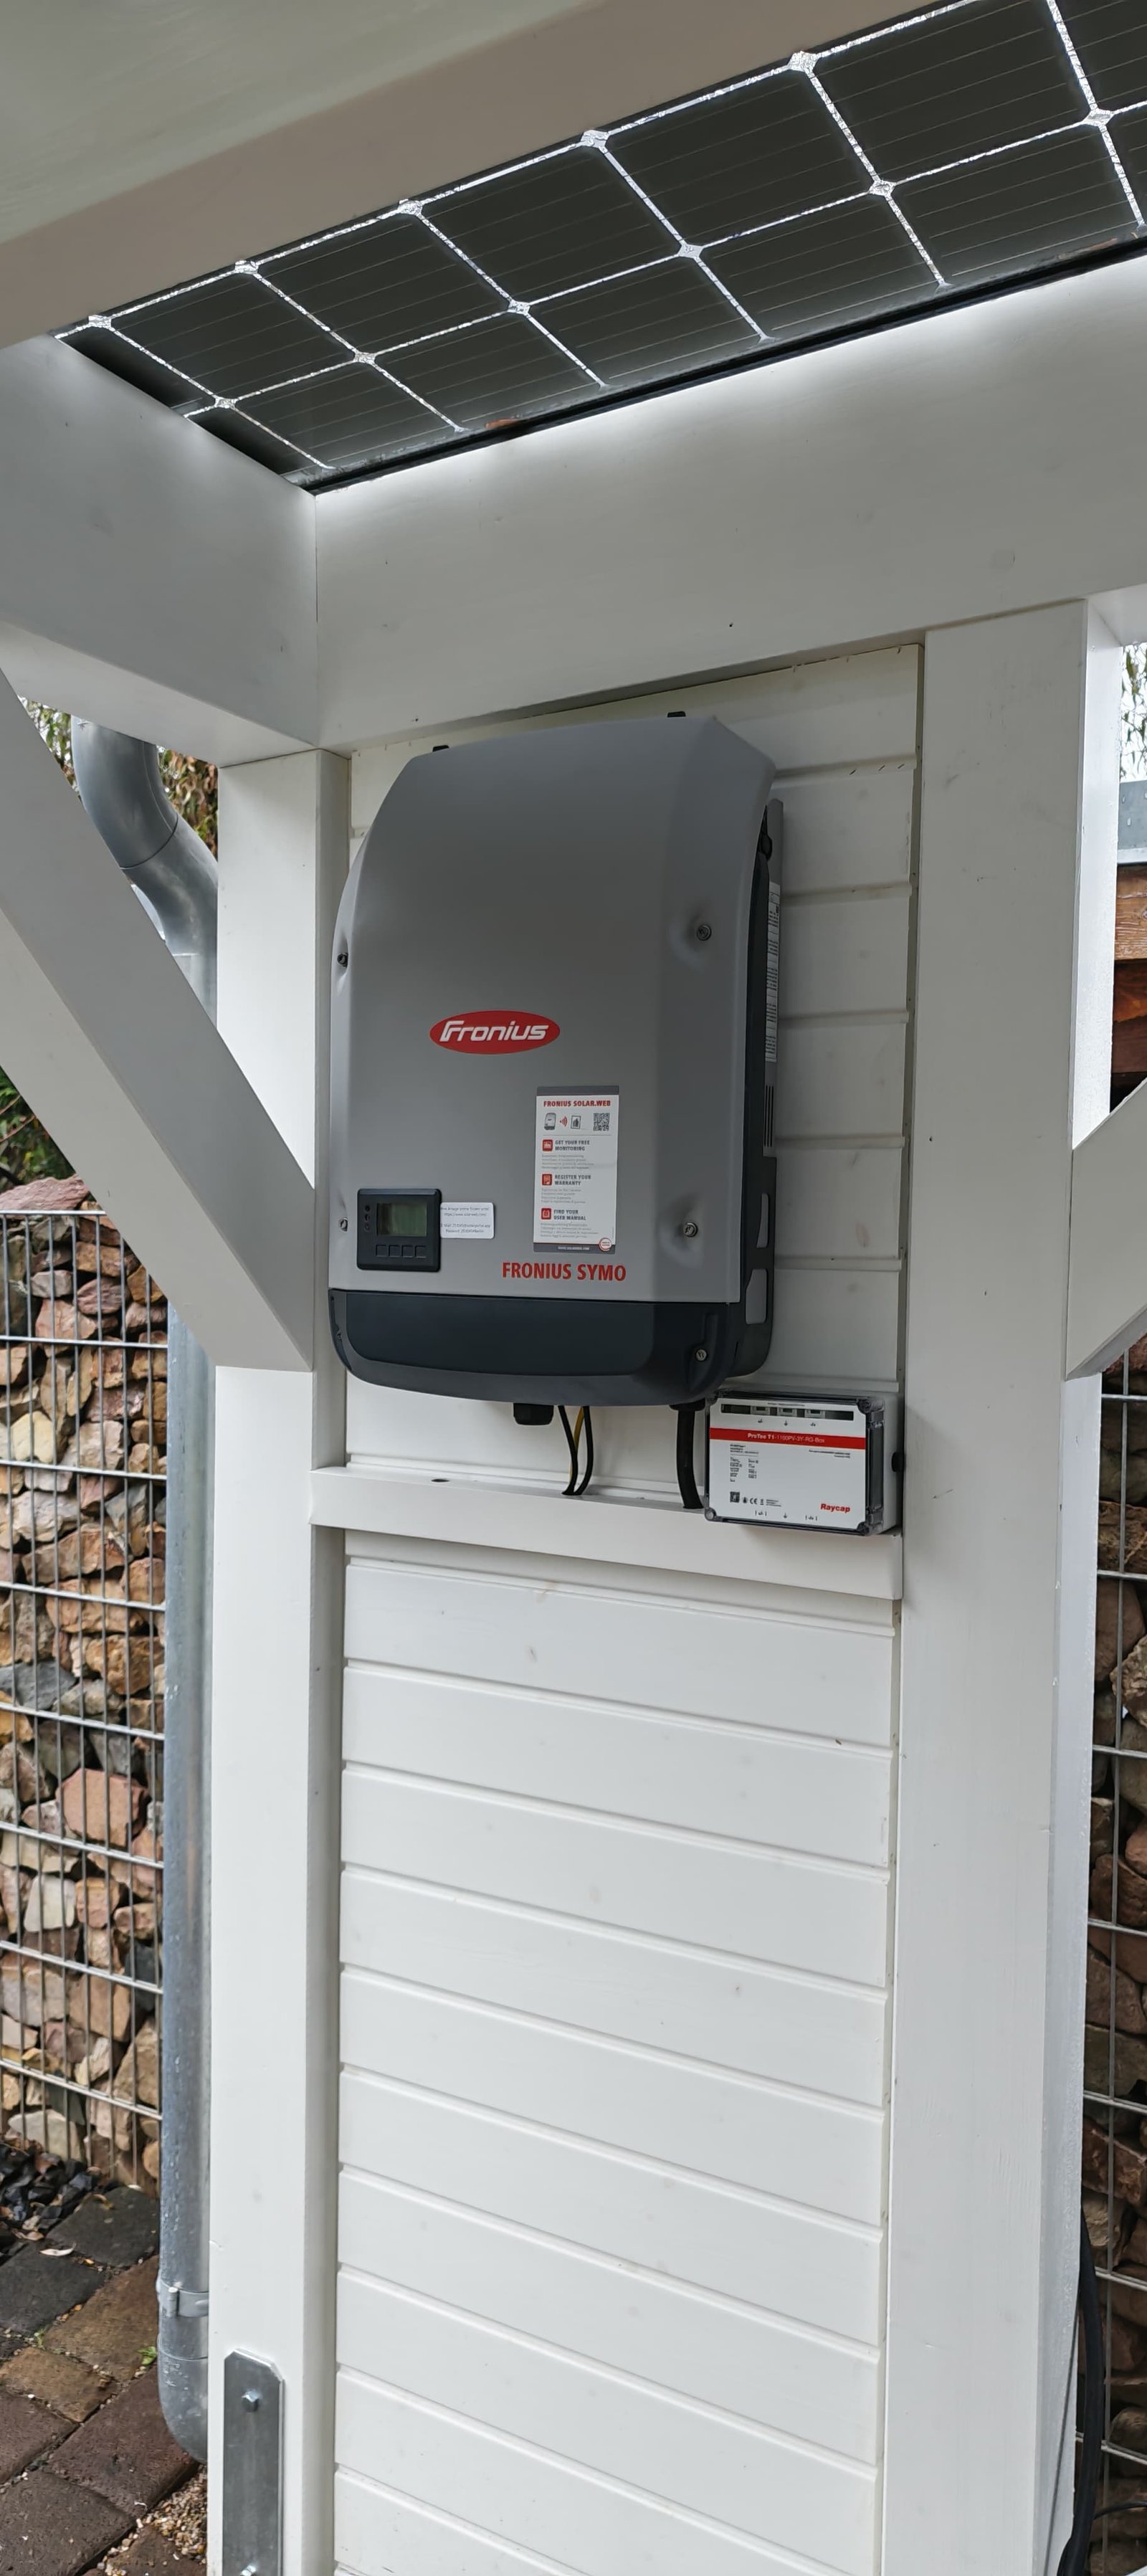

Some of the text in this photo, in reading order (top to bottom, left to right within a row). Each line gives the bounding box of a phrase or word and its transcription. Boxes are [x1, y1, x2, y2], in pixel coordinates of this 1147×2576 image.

[439, 1020, 548, 1042] Fronius
[503, 1262, 626, 1282] FRONIUS SYMO
[820, 1503, 851, 1513] Raycap
